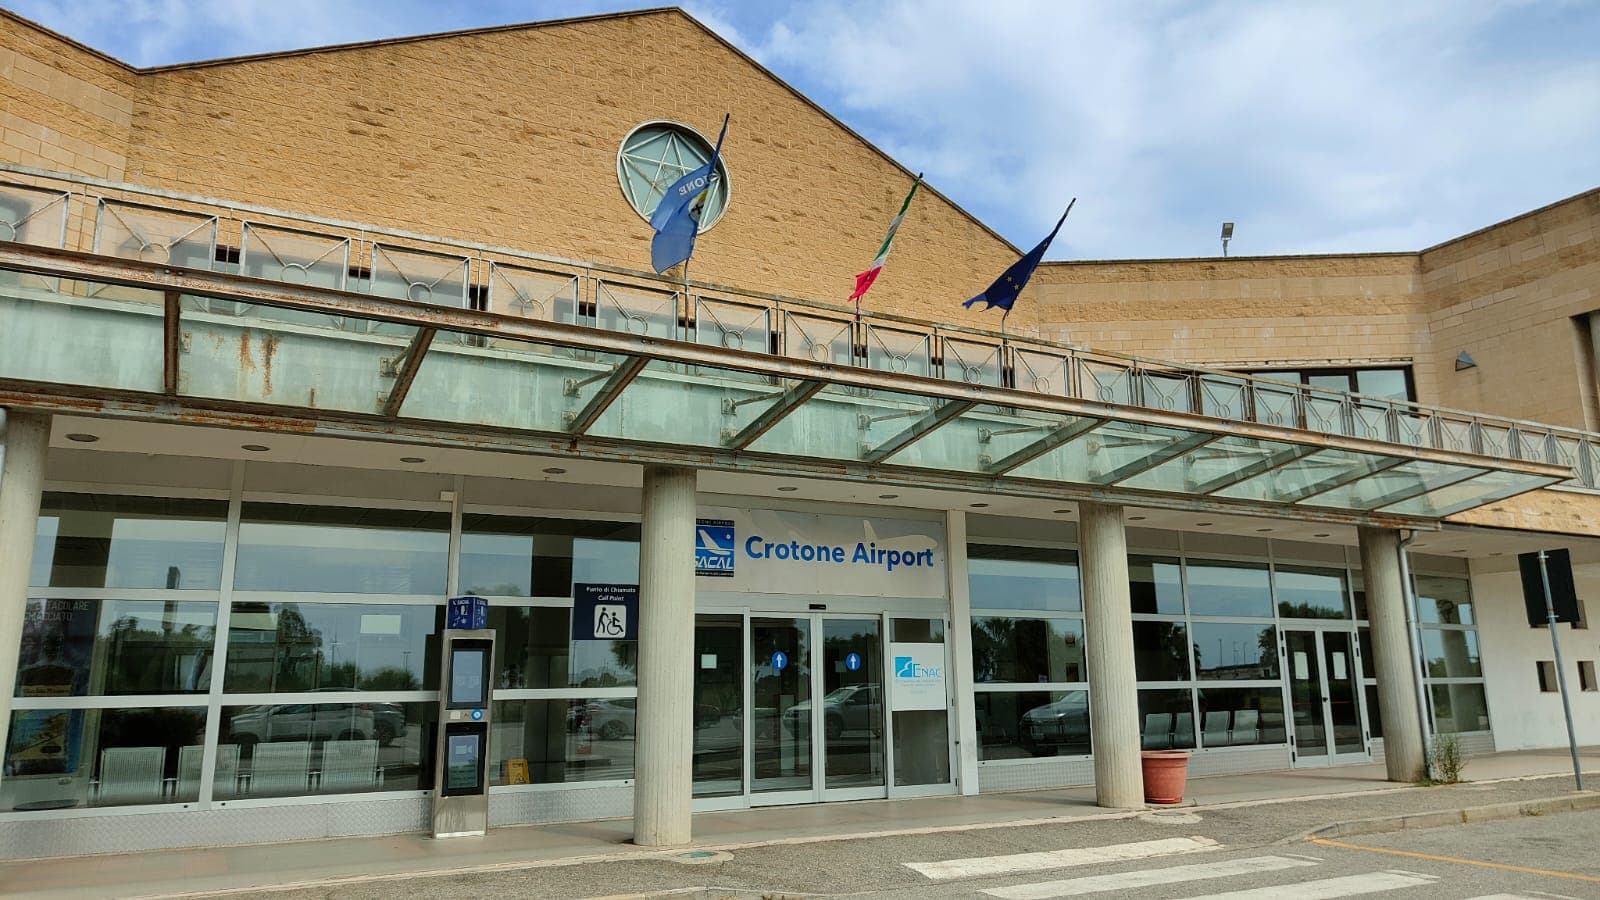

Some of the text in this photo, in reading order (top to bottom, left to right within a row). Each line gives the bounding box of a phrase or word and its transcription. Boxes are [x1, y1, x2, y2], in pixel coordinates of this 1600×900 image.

[745, 536, 933, 571] Crotone Airport
[913, 663, 942, 677] ENAC
